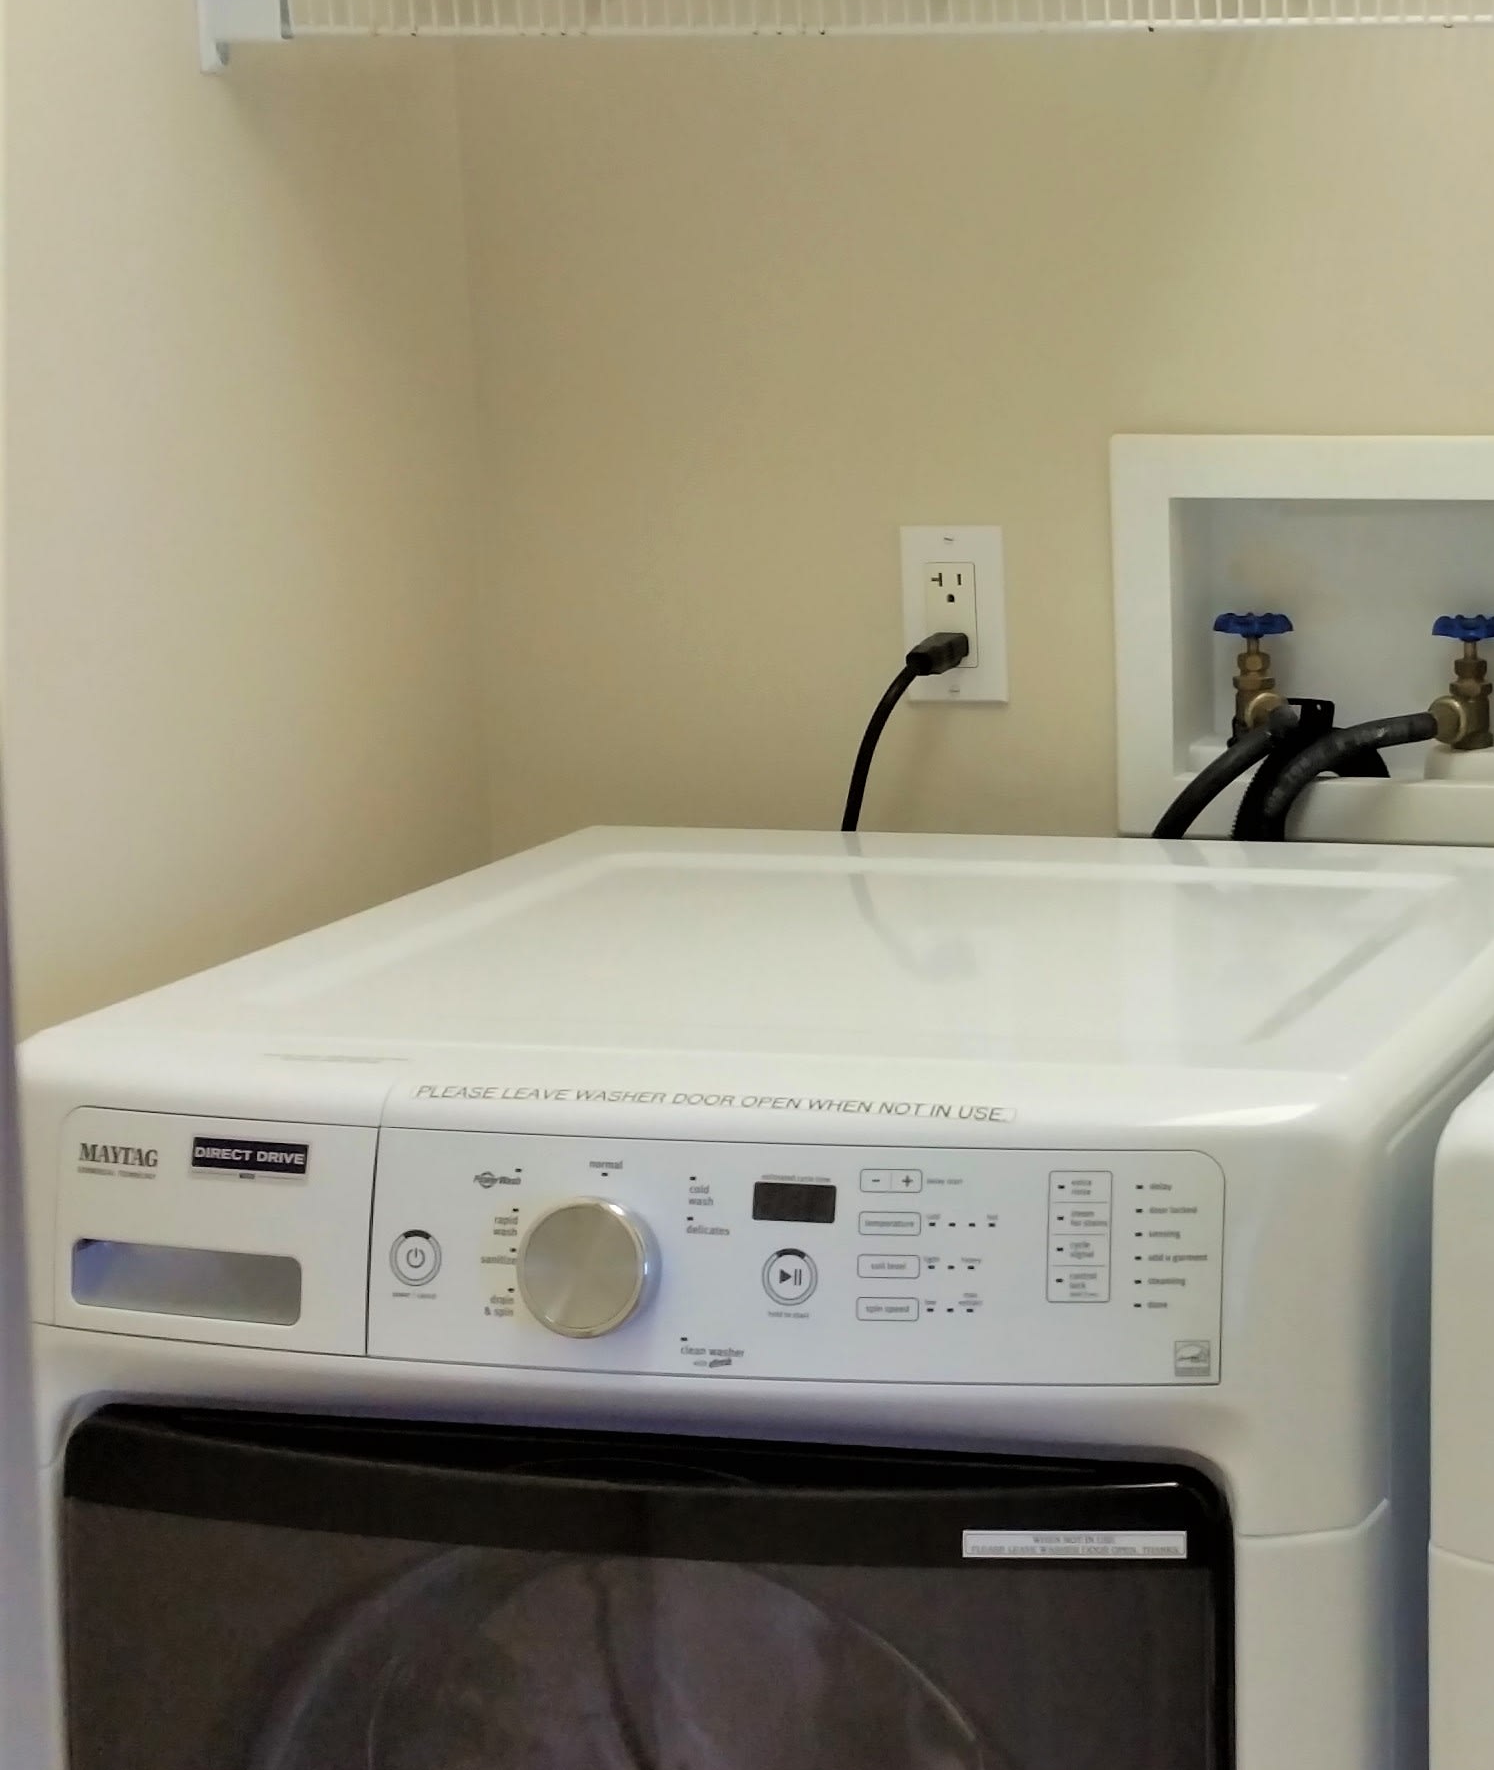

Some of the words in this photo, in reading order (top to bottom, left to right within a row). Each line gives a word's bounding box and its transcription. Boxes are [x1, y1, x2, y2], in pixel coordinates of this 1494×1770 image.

[415, 1085, 498, 1100] PLEASE
[500, 1087, 571, 1101] LEAVE
[575, 1089, 667, 1104] WASHER
[671, 1092, 735, 1106] DOOR
[741, 1095, 801, 1110] OPEN
[808, 1098, 873, 1113] WHEN
[878, 1101, 924, 1116] NOT
[929, 1104, 951, 1118] IN
[79, 1142, 159, 1168] MAYTAG
[194, 1146, 254, 1162] DIRECT
[256, 1151, 306, 1166] DRIVE
[589, 1160, 624, 1170] normal
[689, 1184, 710, 1195] cold
[688, 1196, 714, 1207] wash
[680, 1345, 707, 1357] clean
[708, 1347, 745, 1359] washer
